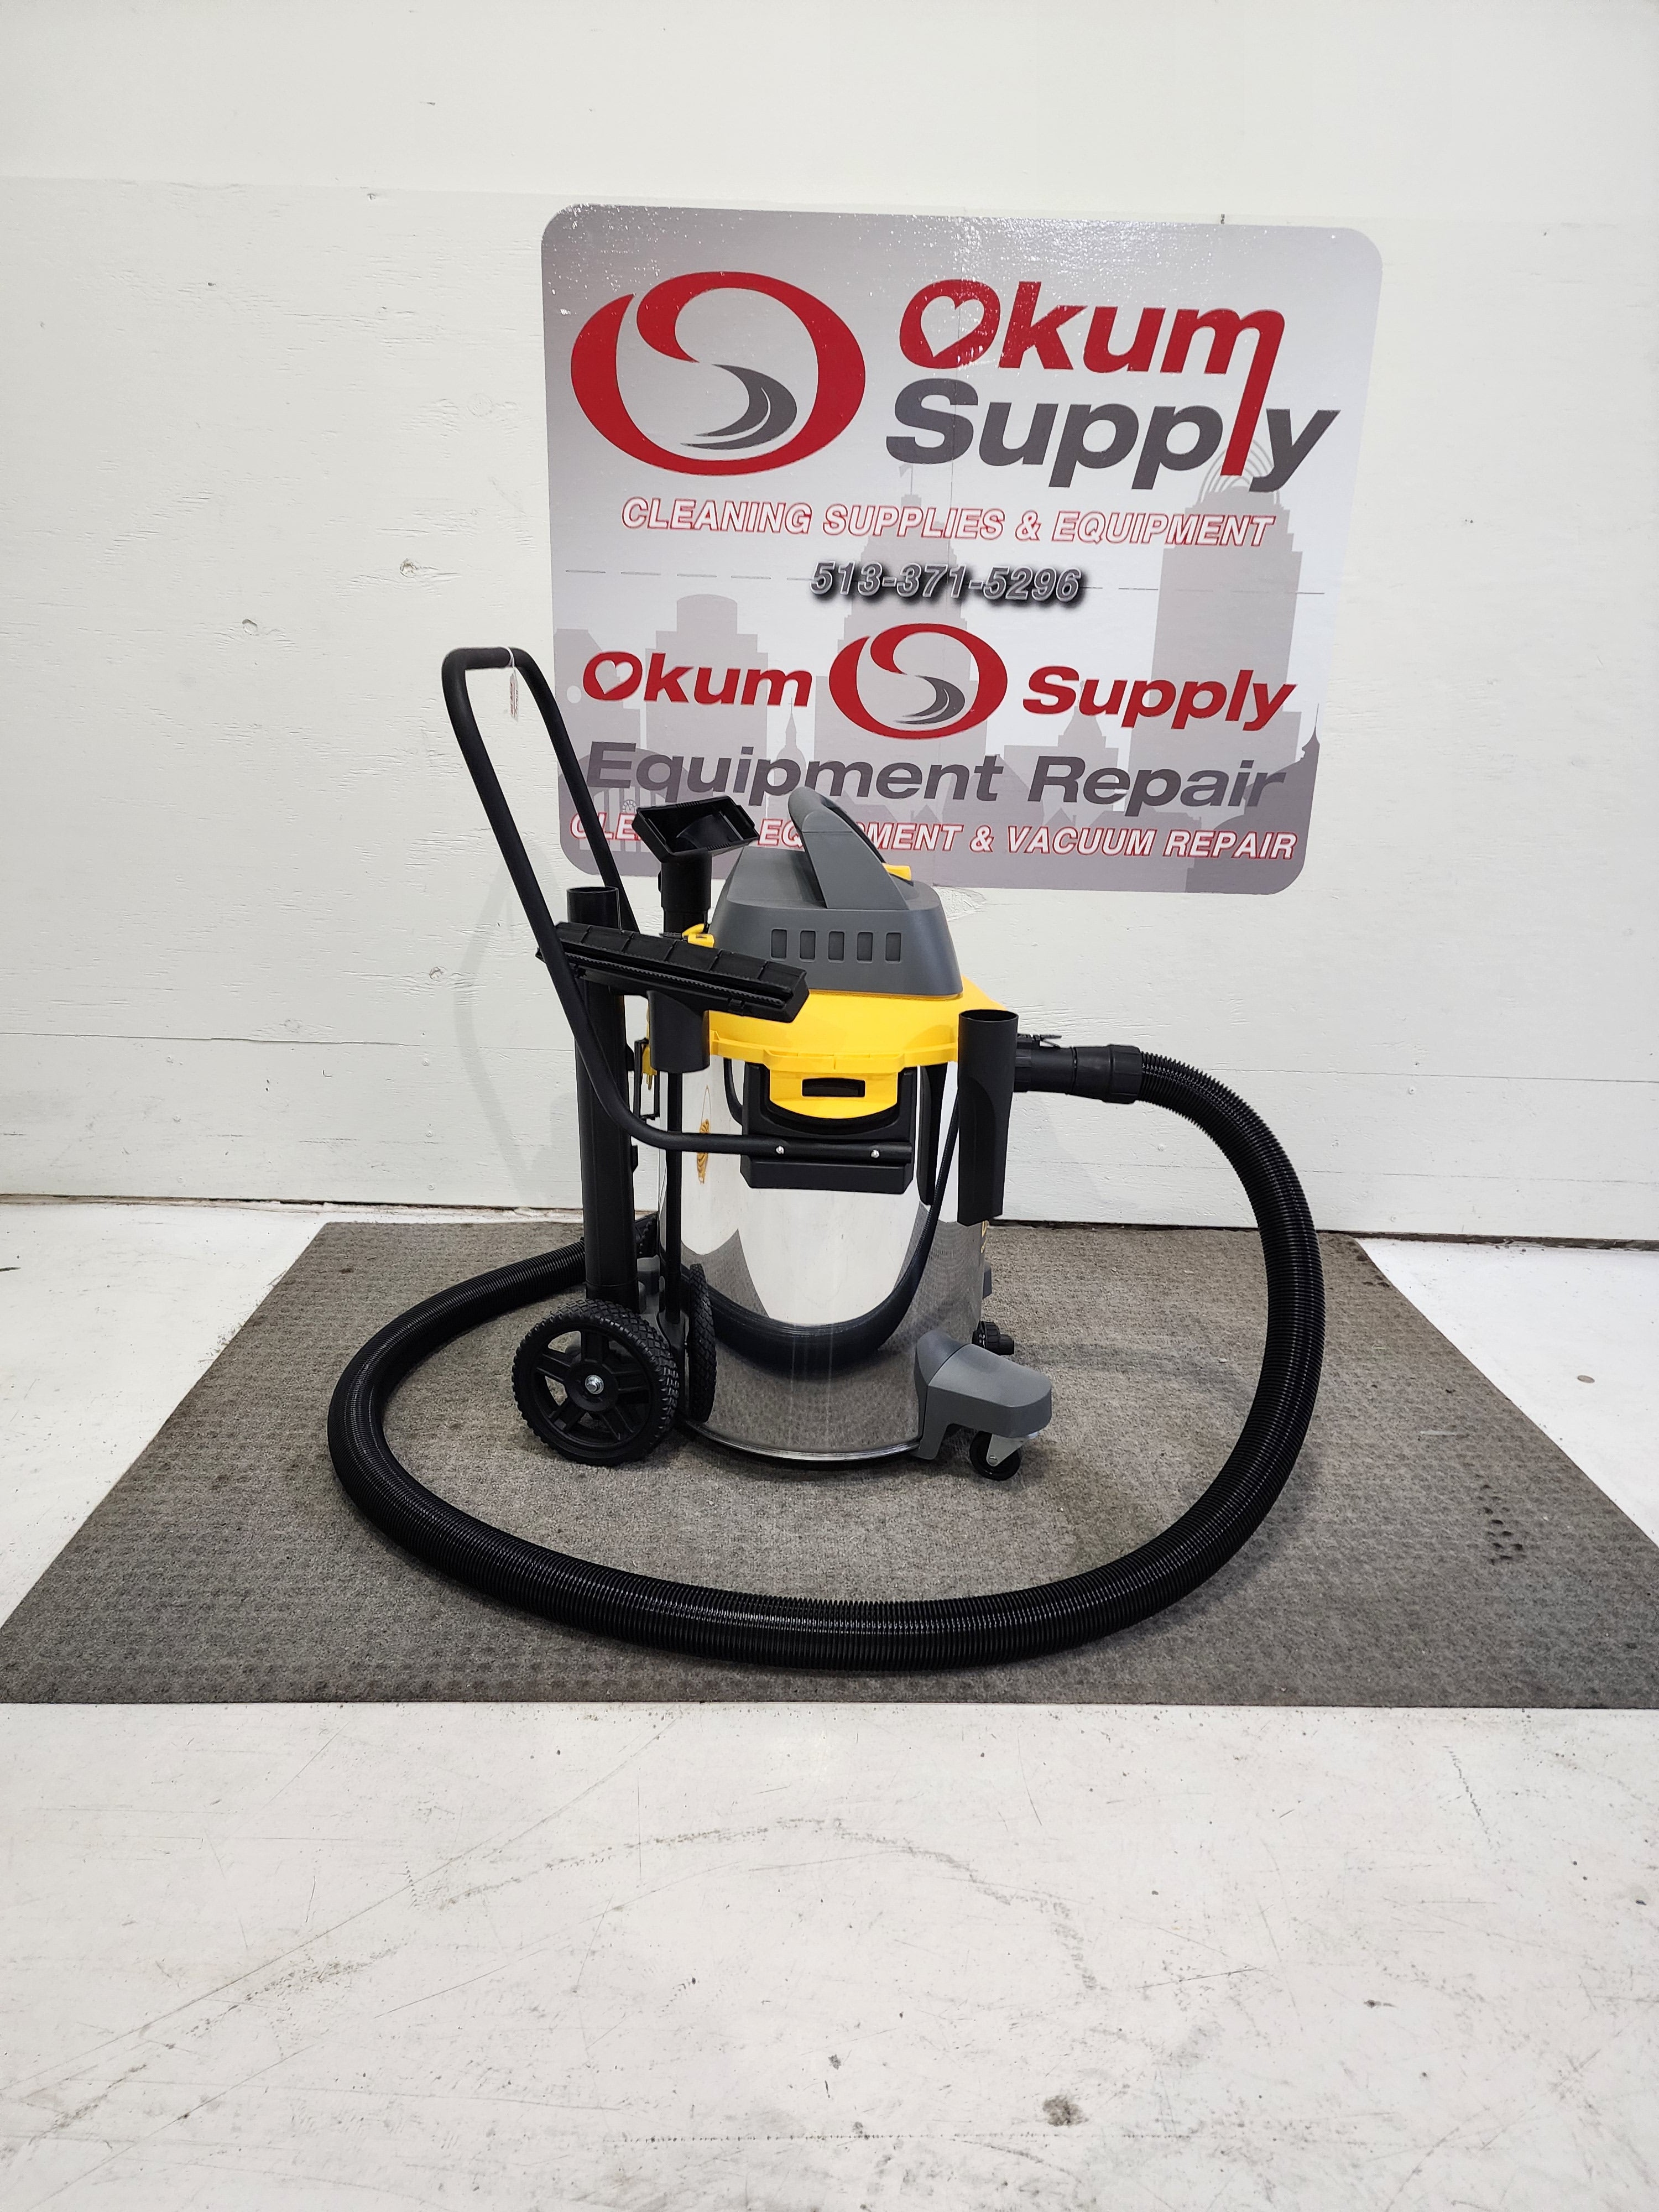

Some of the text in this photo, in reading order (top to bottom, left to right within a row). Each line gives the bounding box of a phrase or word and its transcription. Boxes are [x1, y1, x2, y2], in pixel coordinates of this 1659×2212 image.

[899, 279, 1285, 382] Okum
[886, 378, 1340, 493] Supply
[622, 496, 1277, 546] CLEANING SUPPLIES & EQUIPMENT
[810, 561, 1082, 602] 513-371-5296
[582, 651, 813, 707] Okum
[1022, 666, 1298, 731] Supply
[586, 741, 1287, 817] Equipment Repair
[758, 818, 1298, 860] EQMENT & VACUUM REPAIR
